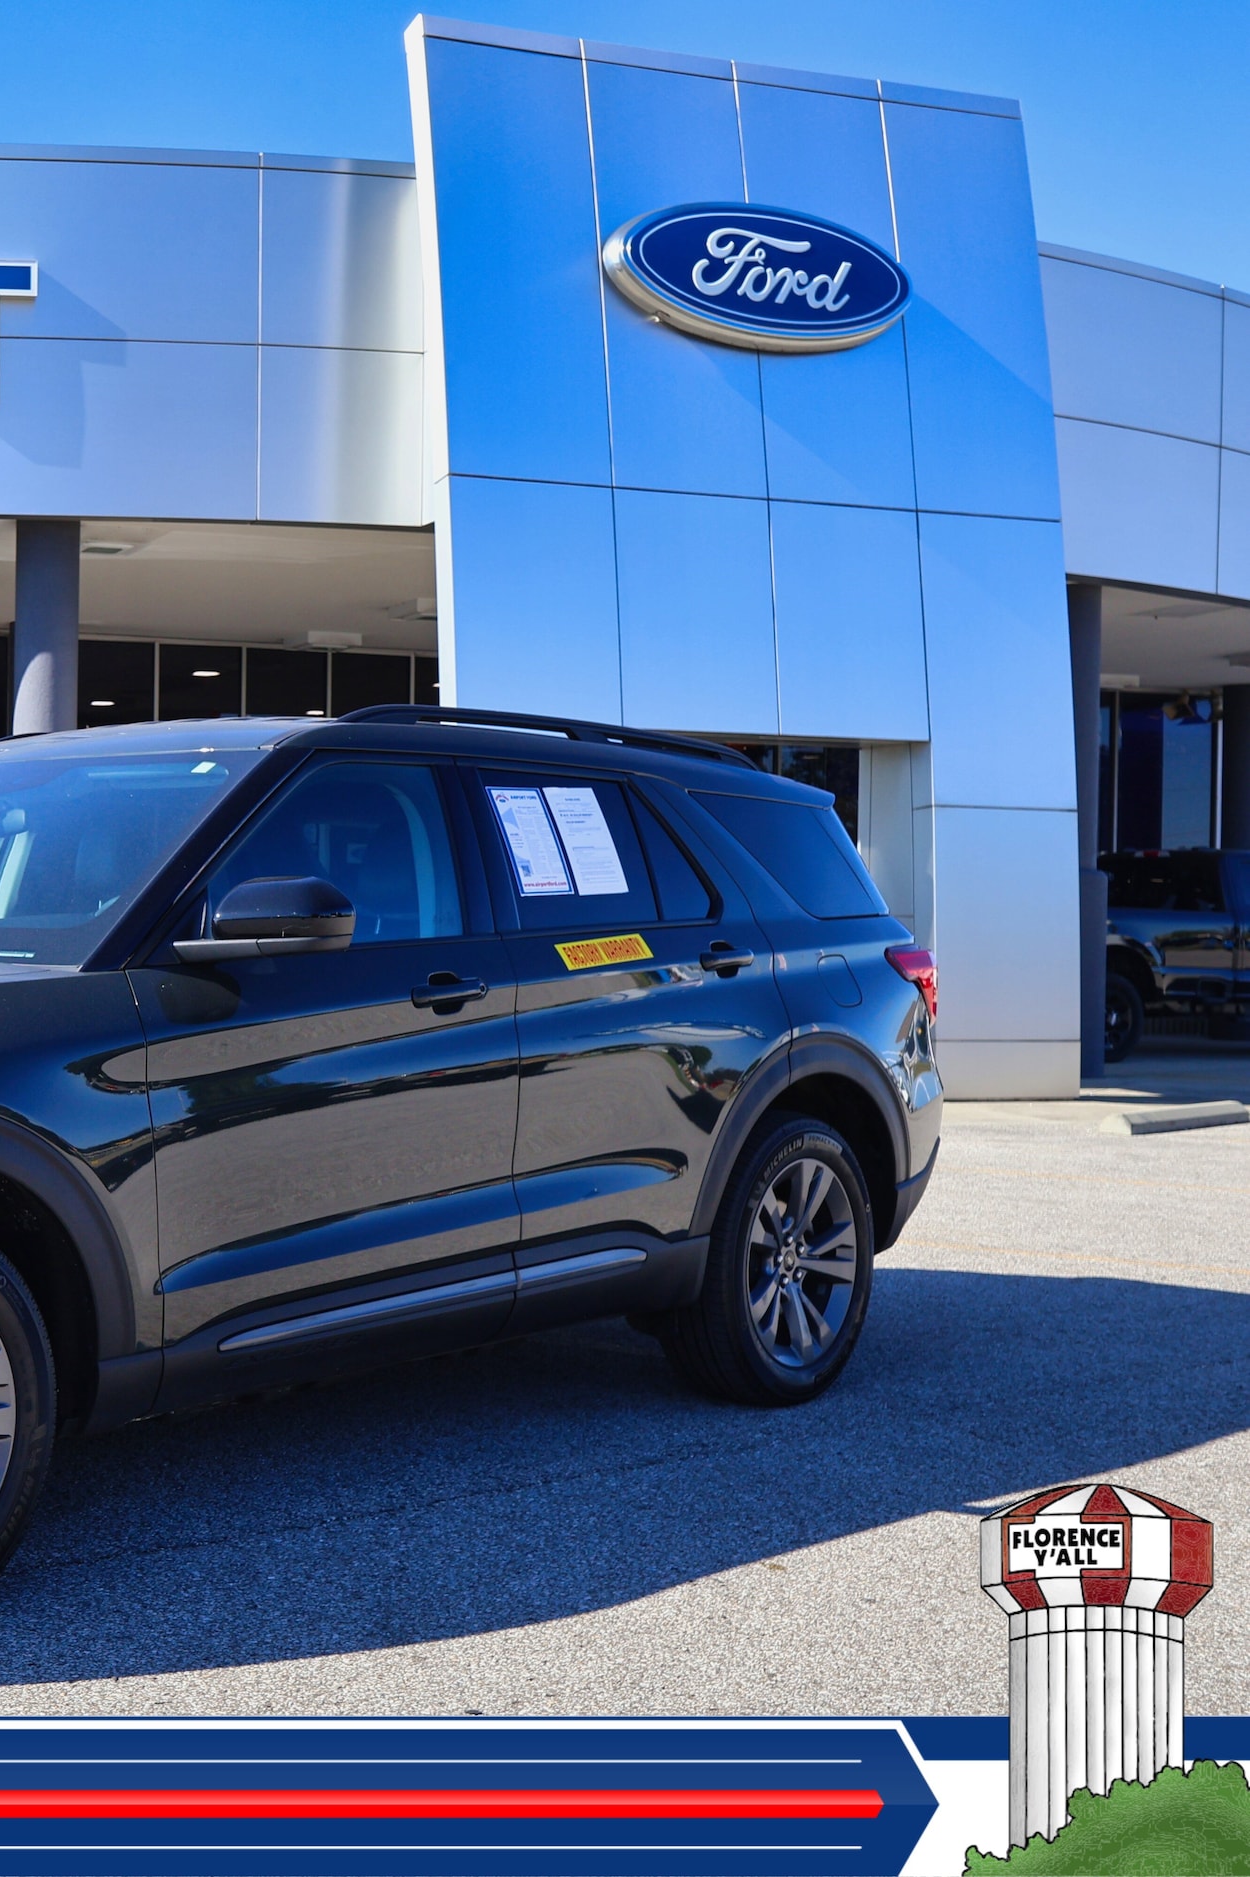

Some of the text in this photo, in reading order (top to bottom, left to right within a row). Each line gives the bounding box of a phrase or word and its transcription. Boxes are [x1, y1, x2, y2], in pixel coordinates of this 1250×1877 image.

[691, 227, 852, 312] Ford
[562, 937, 647, 968] FACTORY WARRANTY
[763, 1137, 803, 1179] MICHELIN
